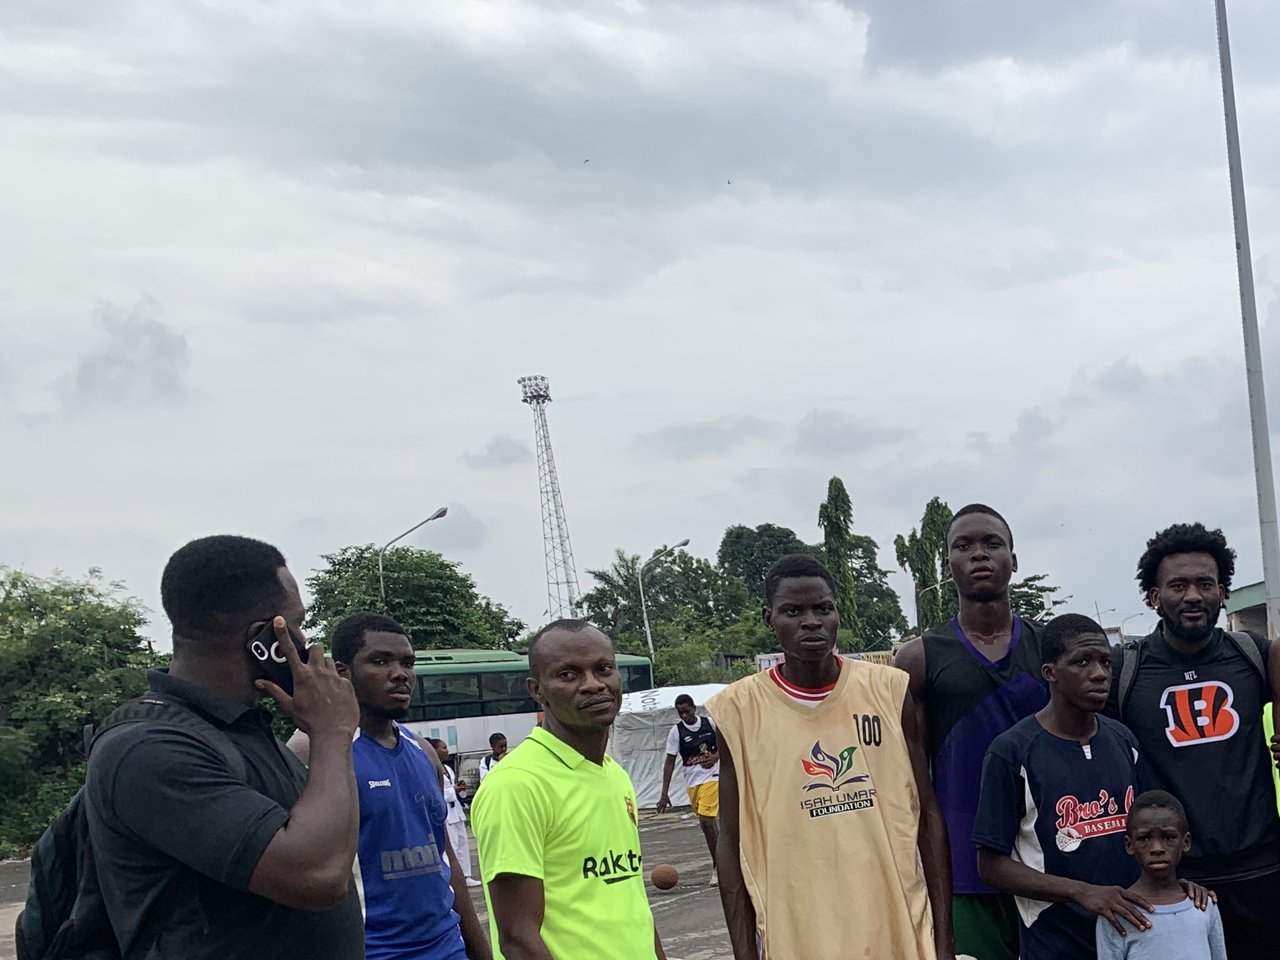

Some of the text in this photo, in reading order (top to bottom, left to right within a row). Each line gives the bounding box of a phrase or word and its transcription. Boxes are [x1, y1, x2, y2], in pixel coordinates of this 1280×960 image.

[1184, 670, 1198, 681] NFL
[853, 714, 882, 747] 100
[801, 789, 877, 810] ISAH UMAR
[812, 801, 871, 817] FOUNDATION
[1055, 789, 1118, 830] Bro's
